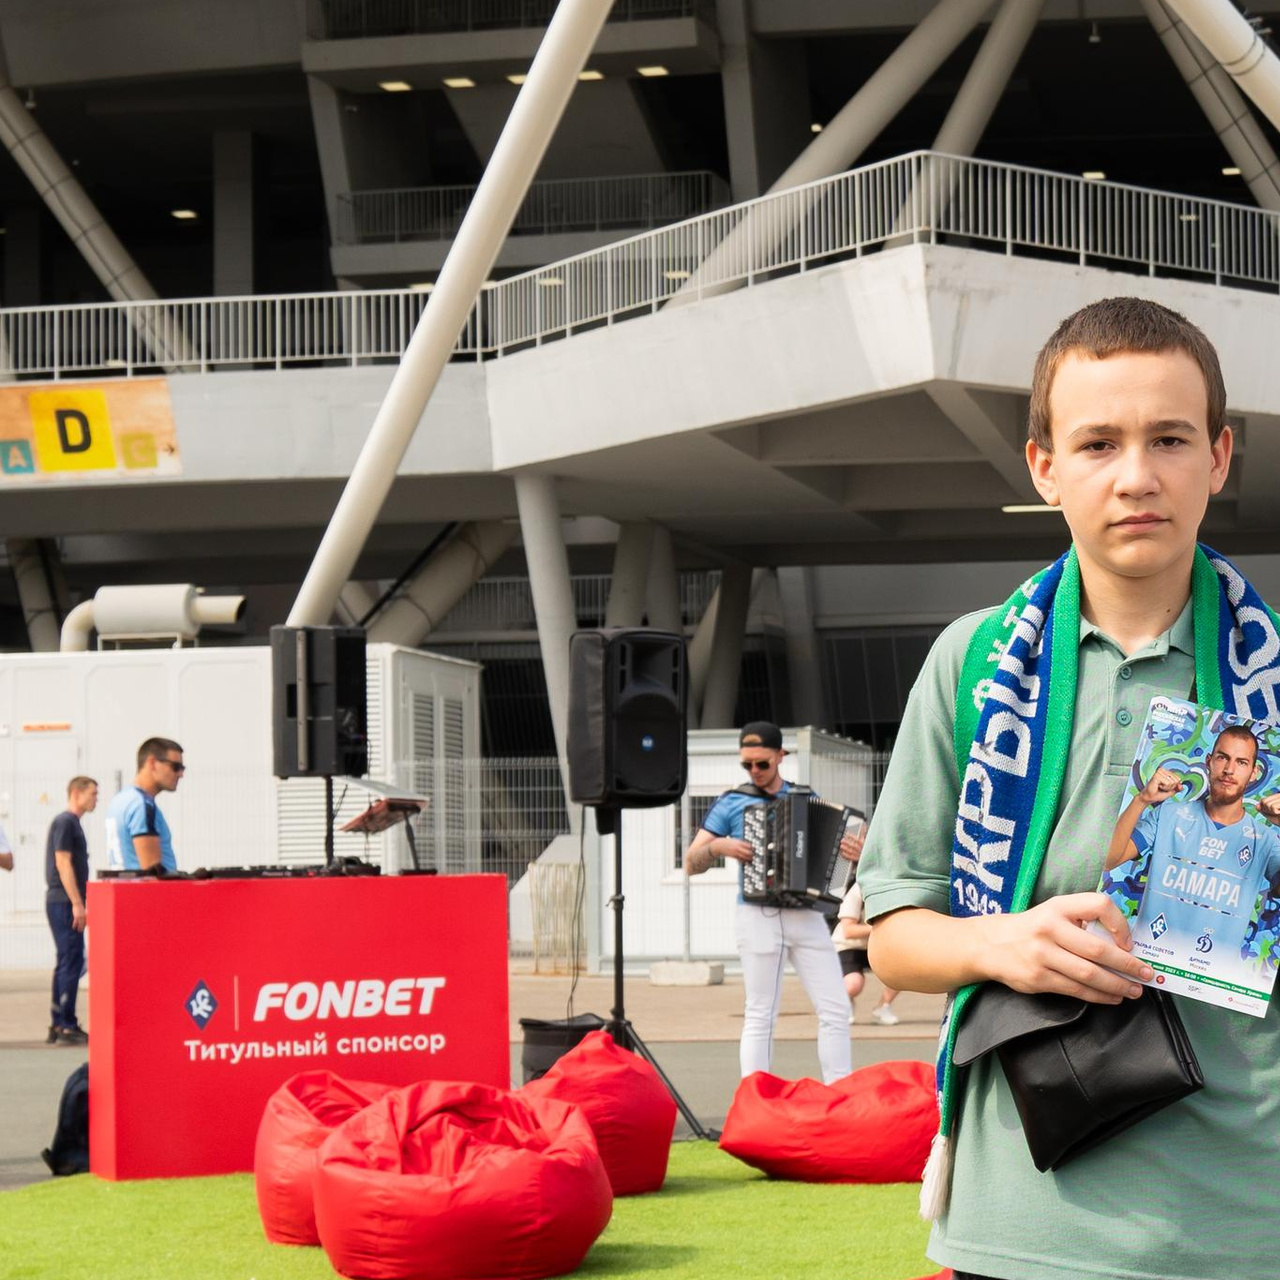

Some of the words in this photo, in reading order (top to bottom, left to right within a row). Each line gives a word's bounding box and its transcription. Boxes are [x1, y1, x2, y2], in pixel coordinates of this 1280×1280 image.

[8, 445, 28, 469] A
[55, 408, 92, 454] D
[1198, 846, 1225, 860] BET
[1200, 836, 1228, 851] FON
[1162, 864, 1241, 908] САМАРА
[253, 977, 446, 1022] FONBET
[184, 1033, 328, 1064] Титульный
[336, 1033, 447, 1054] спонсор
